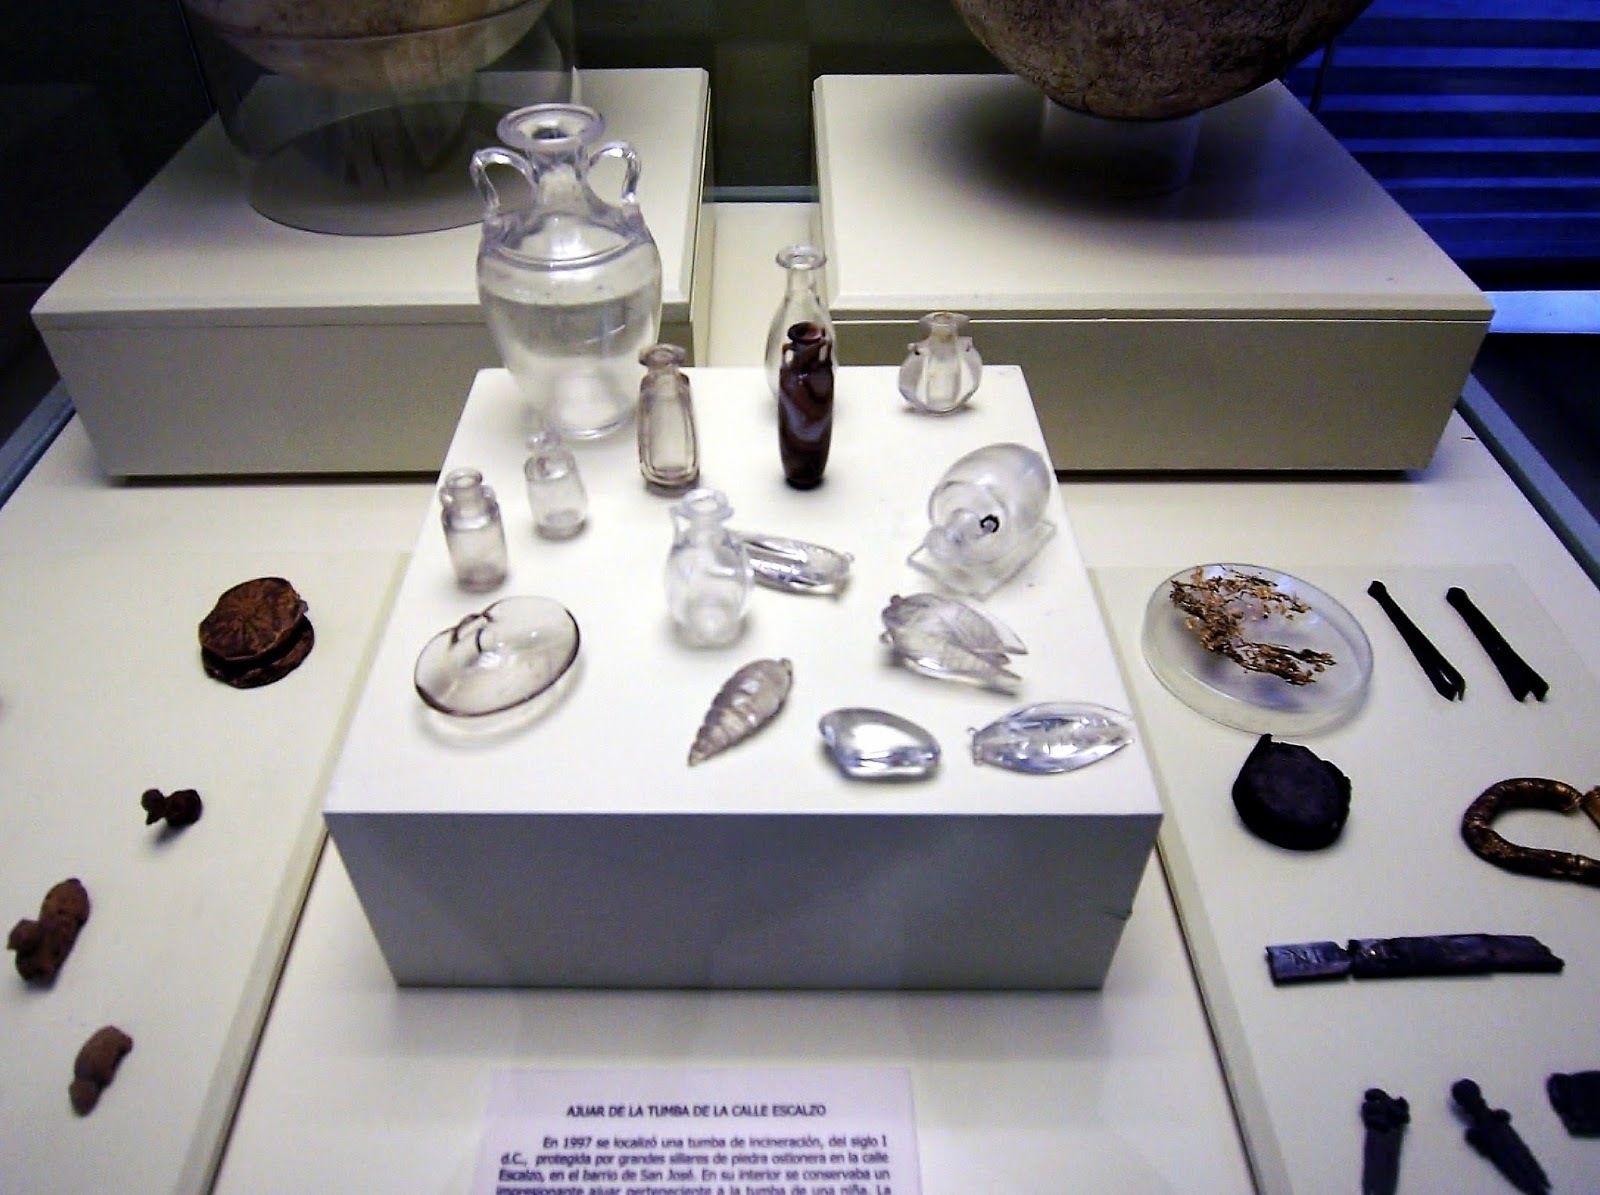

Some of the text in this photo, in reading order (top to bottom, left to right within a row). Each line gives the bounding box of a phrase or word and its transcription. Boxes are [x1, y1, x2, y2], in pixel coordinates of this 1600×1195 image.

[567, 1105, 826, 1117] AJUAR DE LA TUMBA DE LA CALLE ESCALZO
[543, 1137, 558, 1148] En
[564, 1137, 592, 1148] 1997
[597, 1137, 609, 1148] se
[613, 1135, 658, 1148] localizó
[662, 1139, 683, 1148] una
[688, 1137, 725, 1148] tumba
[730, 1137, 744, 1148] de
[749, 1135, 824, 1150] incineración,
[829, 1136, 846, 1148] del
[851, 1136, 878, 1150] siglo
[535, 1154, 591, 1167] protegida
[595, 1155, 614, 1167] por
[618, 1153, 665, 1167] grandes
[713, 1153, 727, 1164] de
[731, 1152, 768, 1167] piedra
[772, 1153, 826, 1164] ostionera
[830, 1154, 845, 1164] en
[848, 1151, 858, 1164] la
[863, 1151, 889, 1164] calle
[498, 1170, 544, 1183] Escalzo,
[549, 1172, 565, 1181] en
[568, 1170, 579, 1181] el
[583, 1170, 618, 1181] barrio
[622, 1170, 636, 1181] de
[640, 1170, 663, 1181] San
[702, 1170, 717, 1181] En
[721, 1171, 735, 1181] su
[739, 1170, 781, 1181] interior
[786, 1171, 799, 1181] se
[803, 1168, 870, 1181] conservaba
[875, 1170, 890, 1181] un
[590, 1186, 621, 1195] ajuar
[718, 1186, 725, 1195] a
[730, 1186, 740, 1195] la
[746, 1186, 786, 1195] tumba
[790, 1185, 808, 1195] de
[812, 1187, 834, 1195] una
[877, 1185, 891, 1195] La
